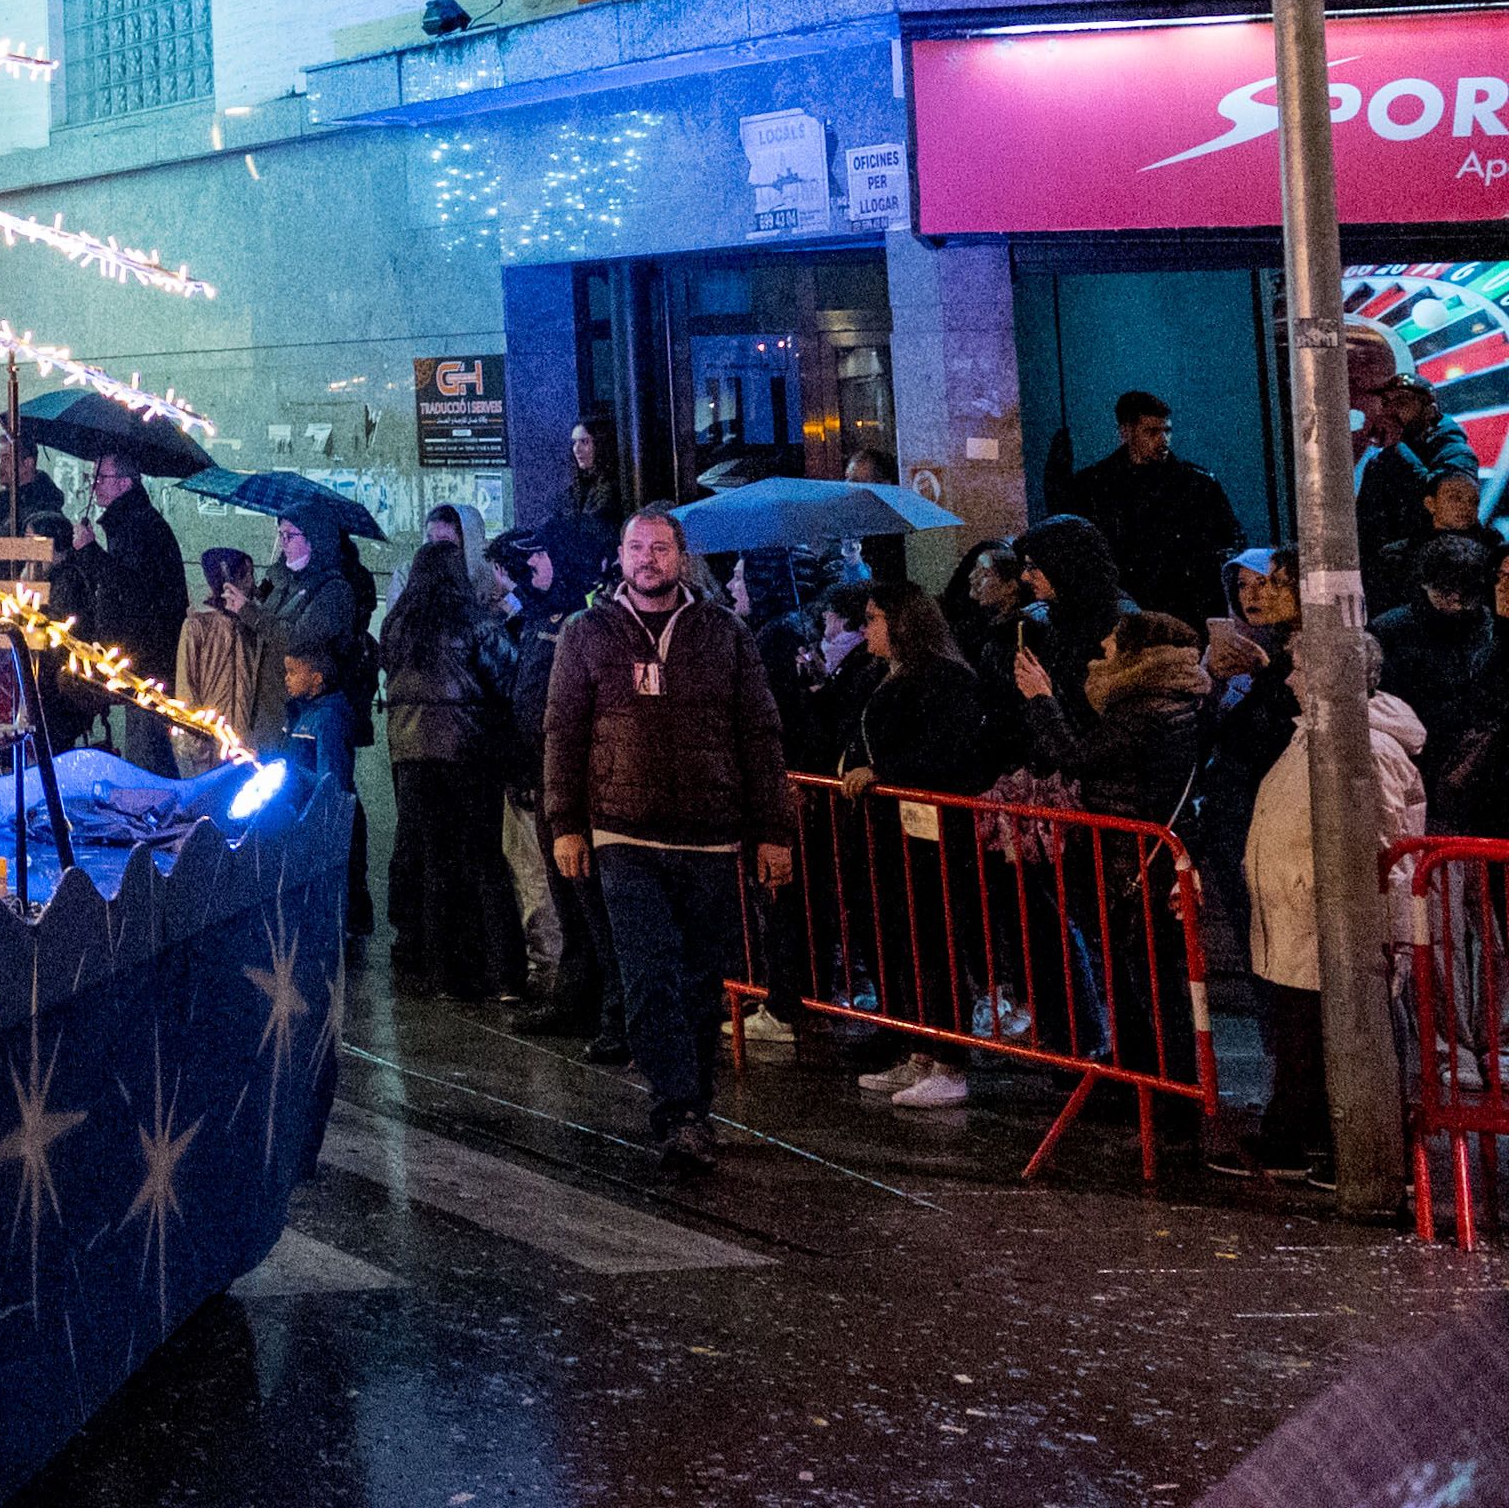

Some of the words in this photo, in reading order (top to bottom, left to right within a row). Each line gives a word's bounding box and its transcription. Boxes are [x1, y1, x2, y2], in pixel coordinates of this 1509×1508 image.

[758, 123, 806, 146] LOCALS
[853, 150, 899, 171] OFICINES
[867, 174, 888, 190] PER
[859, 195, 900, 215] LLOGAR
[419, 398, 467, 415] TRADUCCIÓ
[471, 399, 503, 414] SERVEIS
